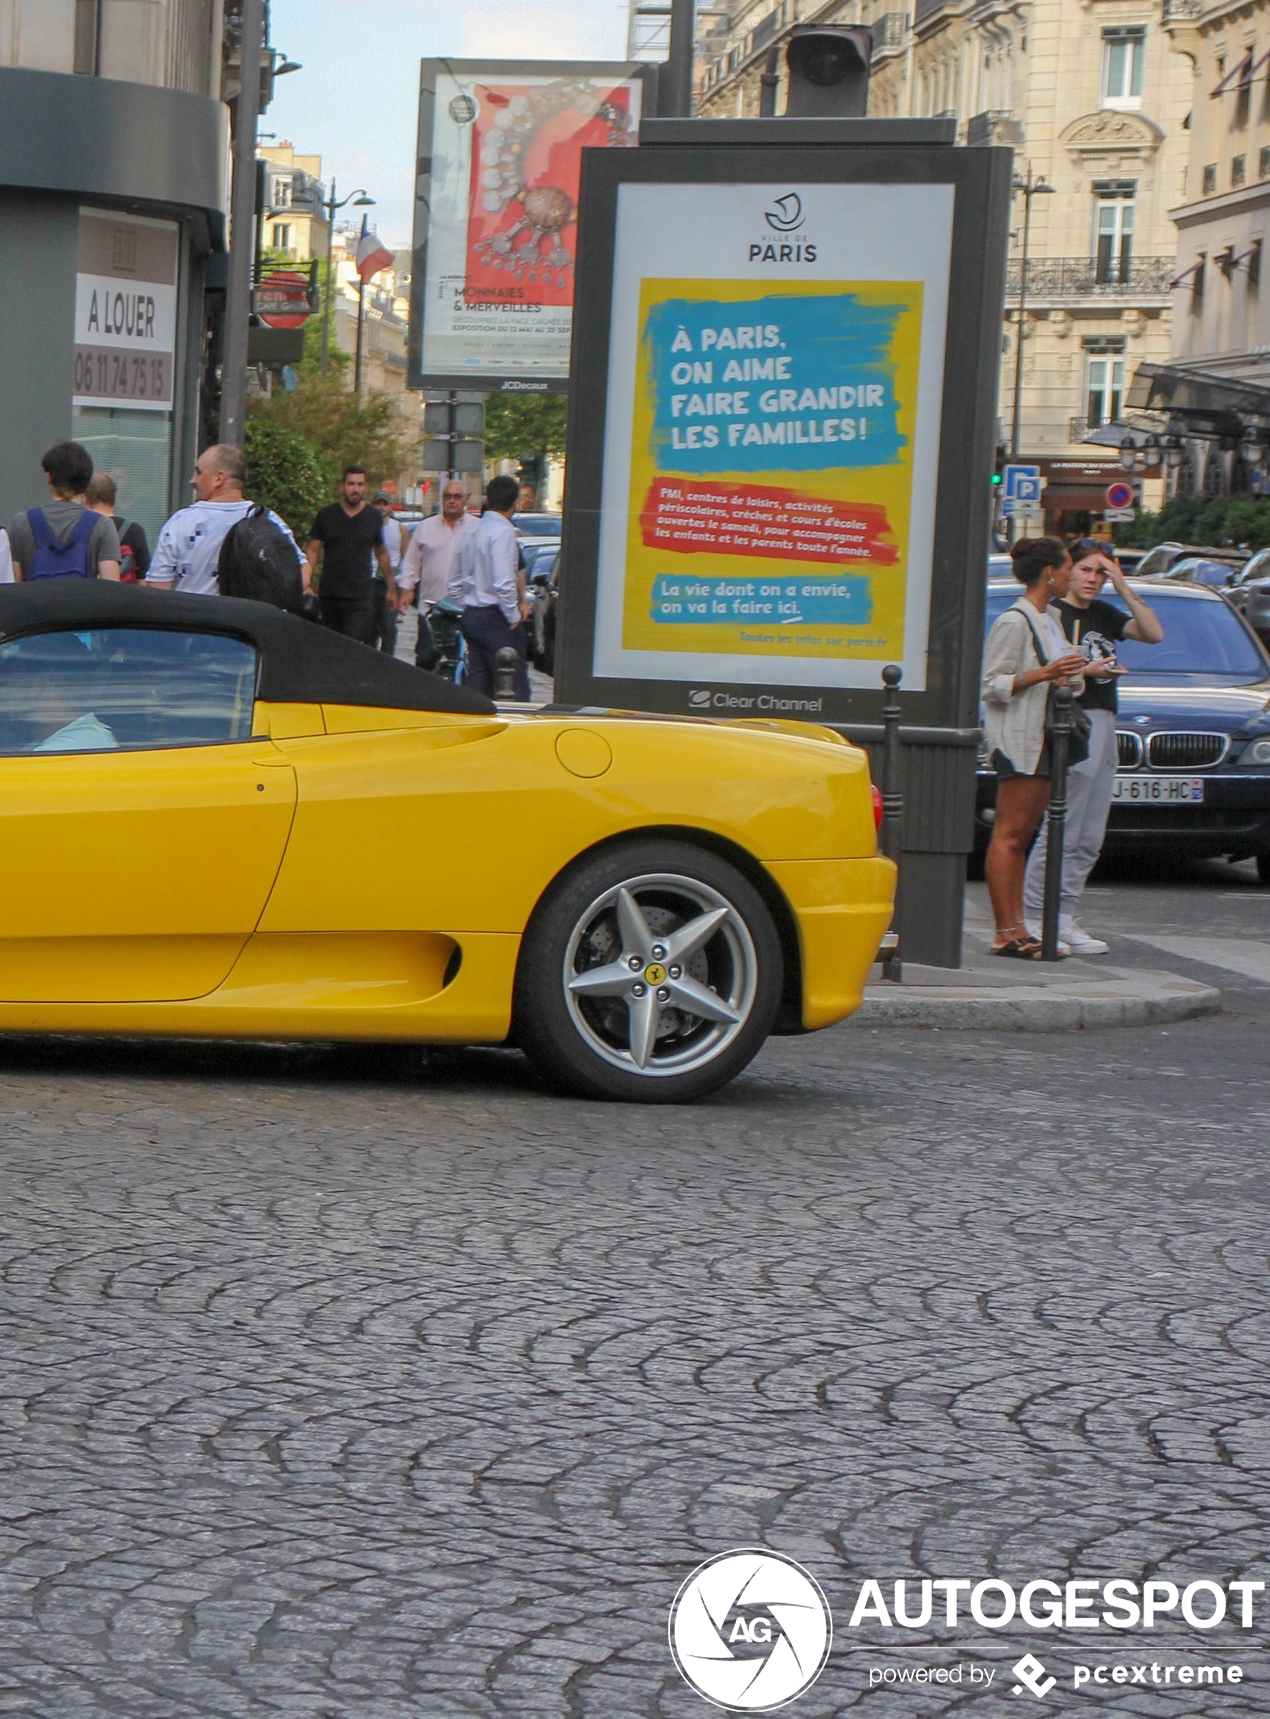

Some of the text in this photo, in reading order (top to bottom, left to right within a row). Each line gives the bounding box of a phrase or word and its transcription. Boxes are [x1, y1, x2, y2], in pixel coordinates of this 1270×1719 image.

[749, 244, 817, 262] PARIS
[454, 287, 525, 298] MONNAIES
[88, 289, 155, 338] A LOUER
[453, 300, 542, 313] & MERVEILLES
[671, 324, 786, 353] À PARIS,
[75, 352, 163, 396] 06 11 74 75 15
[671, 356, 792, 385] ON AIME
[501, 381, 548, 390] JCDecaux
[671, 384, 885, 417] FAIRE GRANDIR
[672, 425, 719, 450] LES
[660, 487, 834, 513] PMI, centres de loisirs, activités
[1022, 482, 1035, 497] P
[658, 503, 729, 518] périscolaires,
[776, 513, 789, 522] et
[792, 516, 822, 525] cours
[657, 516, 865, 544] ouvertes le samedi, pour accompagner
[655, 527, 872, 557] les enfants et les parents toute l'année.
[661, 581, 851, 599] La vie dont on a envie,
[661, 599, 801, 614] on va la faire ici.
[739, 631, 887, 647] Toutes les infos sur paris.fr
[713, 692, 823, 712] Clear Channel
